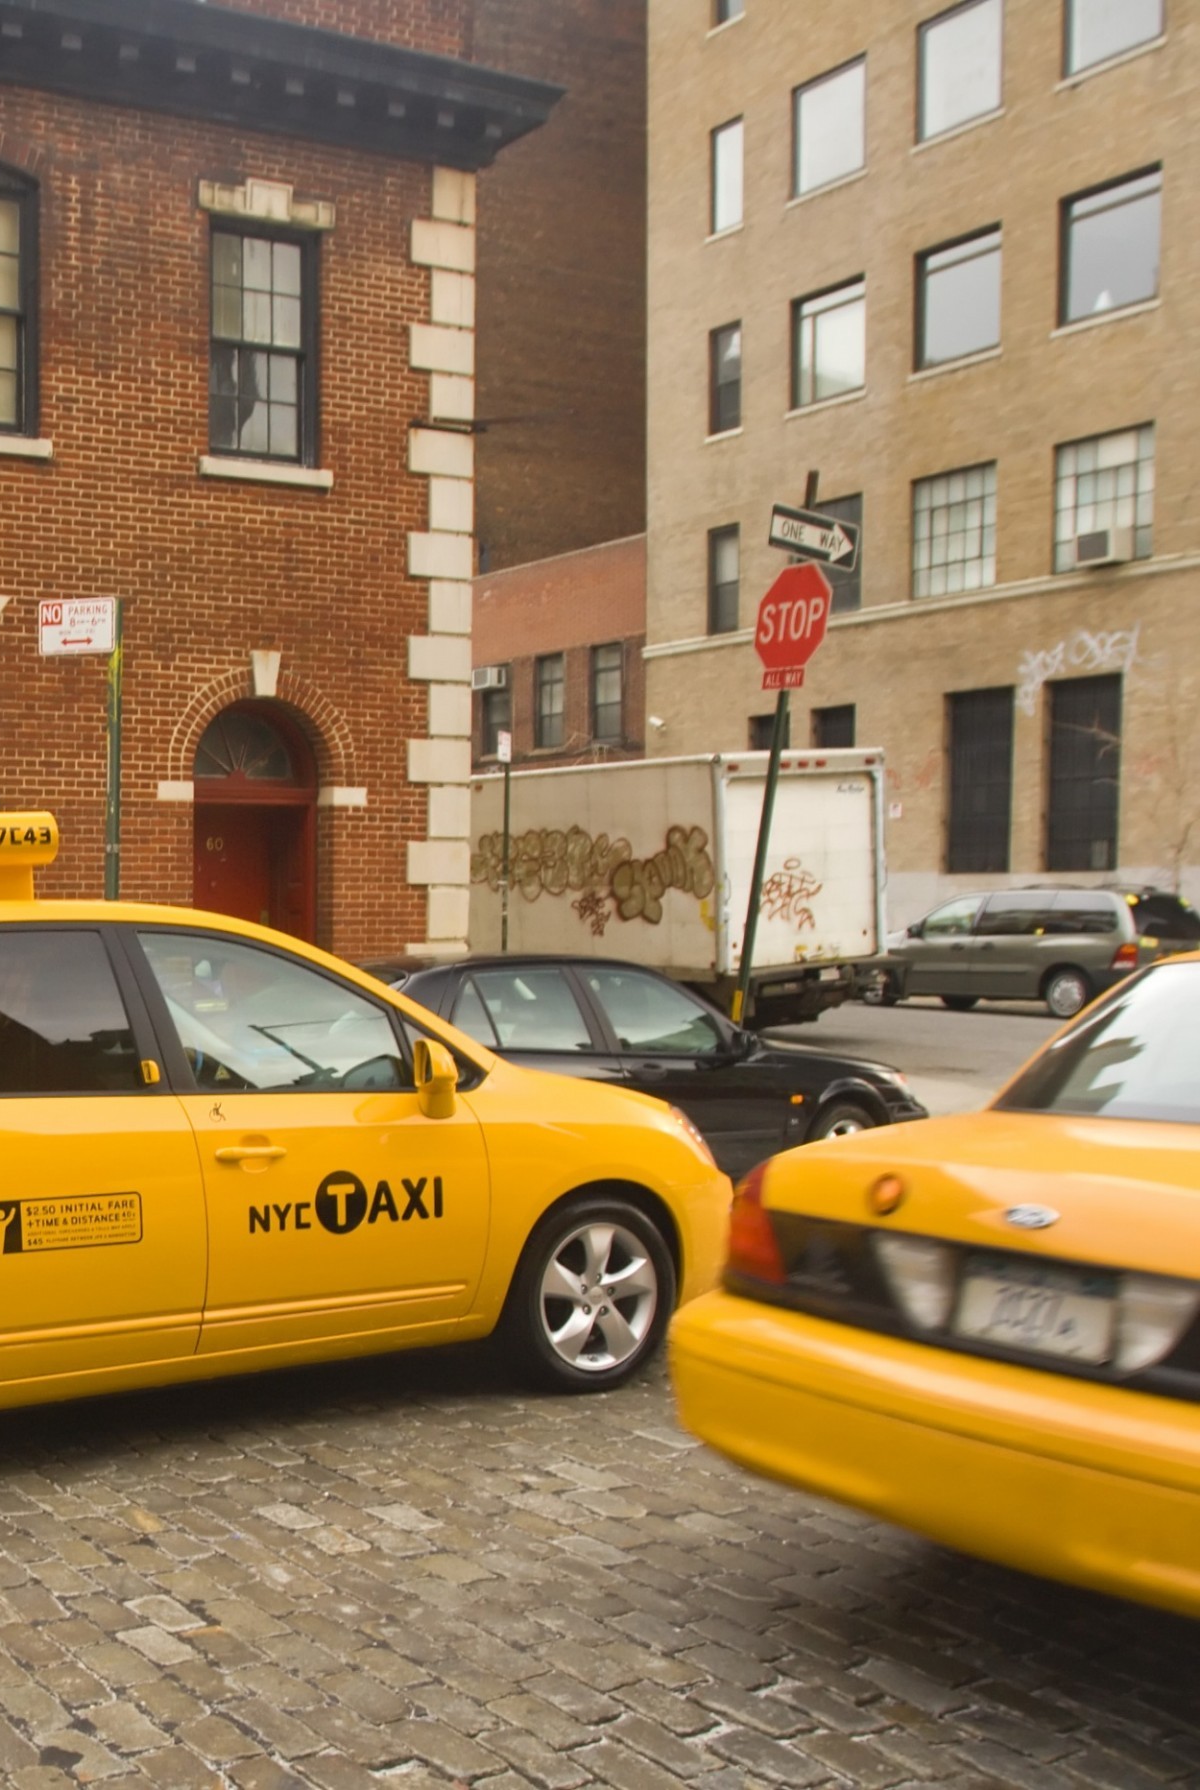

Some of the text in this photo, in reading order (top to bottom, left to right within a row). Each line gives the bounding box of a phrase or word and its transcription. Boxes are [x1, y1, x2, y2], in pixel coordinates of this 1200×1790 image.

[781, 520, 846, 552] ONE WAY
[42, 604, 108, 624] NO PARKING
[759, 597, 825, 644] STOP
[765, 671, 802, 687] ALL WAY
[206, 837, 224, 852] 60
[26, 1199, 135, 1217] $2.50 INITIAL FARE
[249, 1174, 444, 1234] NYC TAXI
[62, 1217, 69, 1226] &
[71, 1213, 120, 1225] DISTANCE
